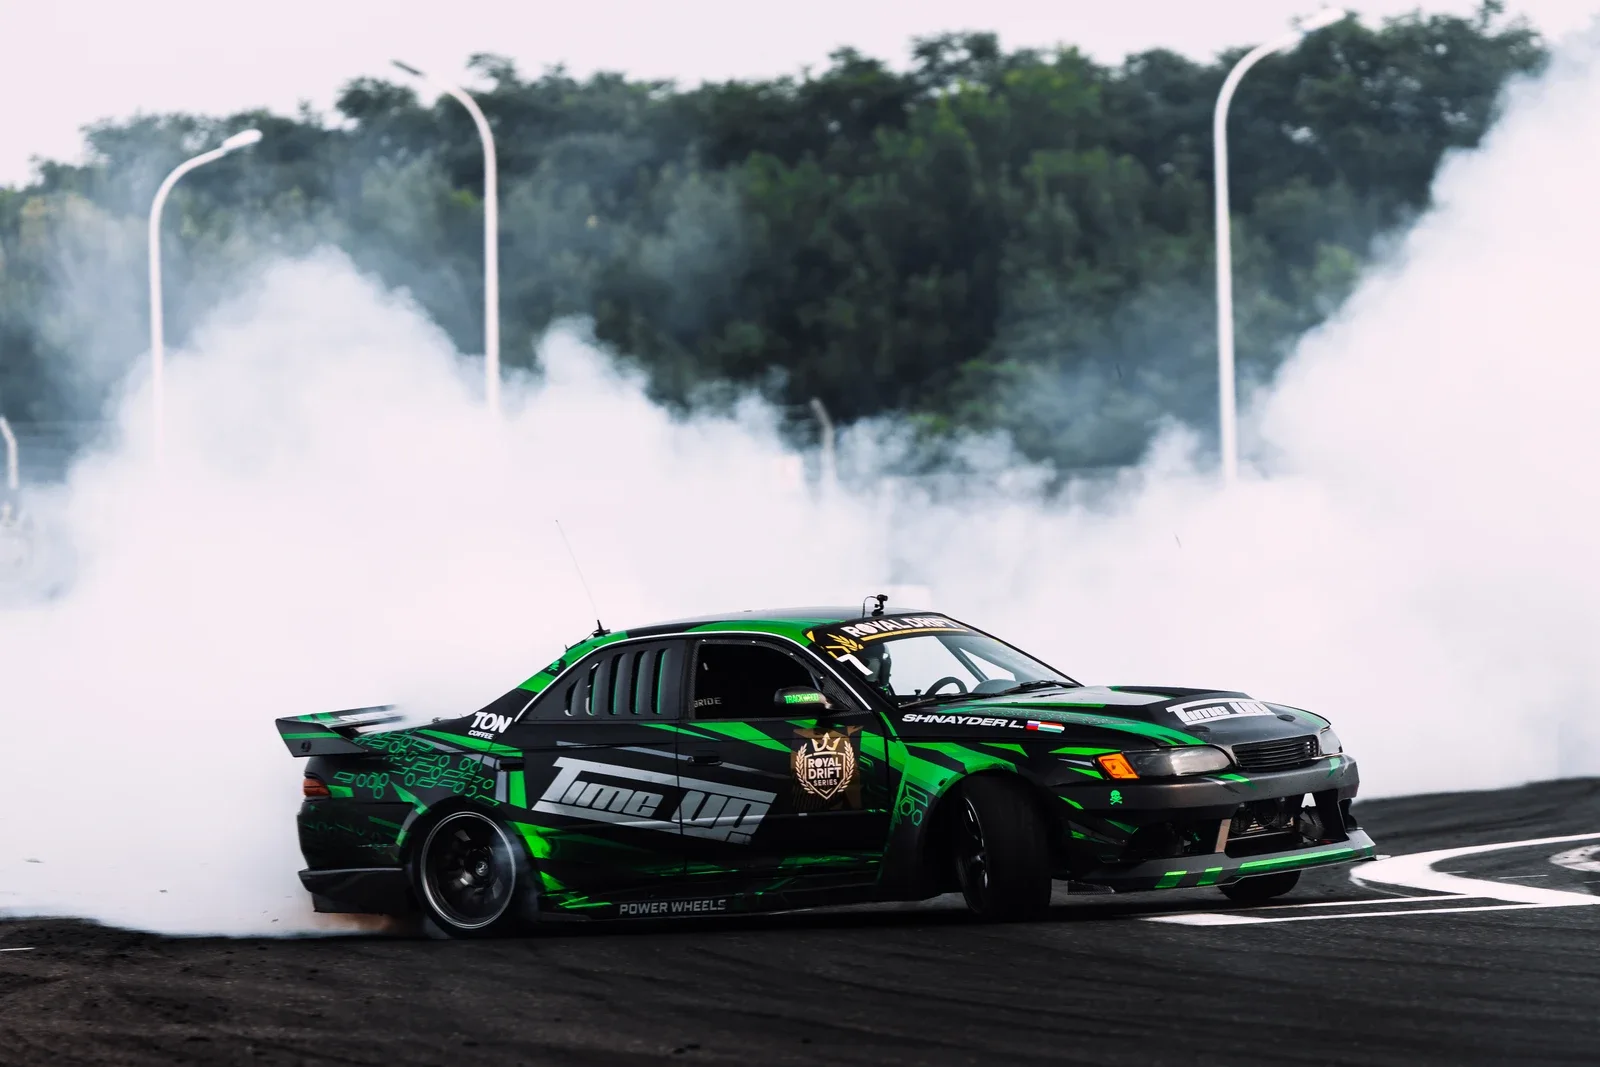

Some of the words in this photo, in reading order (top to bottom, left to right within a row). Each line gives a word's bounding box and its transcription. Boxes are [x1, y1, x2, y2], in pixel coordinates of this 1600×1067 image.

[840, 618, 911, 638] ROYAL
[907, 616, 959, 629] DRIFT
[693, 696, 723, 708] BRIDE
[470, 711, 513, 734] TON
[901, 713, 1006, 728] SHNAYDER
[468, 730, 495, 740] COFFEE
[807, 756, 842, 768] ROYAL
[807, 766, 842, 780] DRIFT
[813, 779, 838, 787] SERIES
[619, 902, 668, 915] POWER
[671, 899, 727, 913] WHEELS
